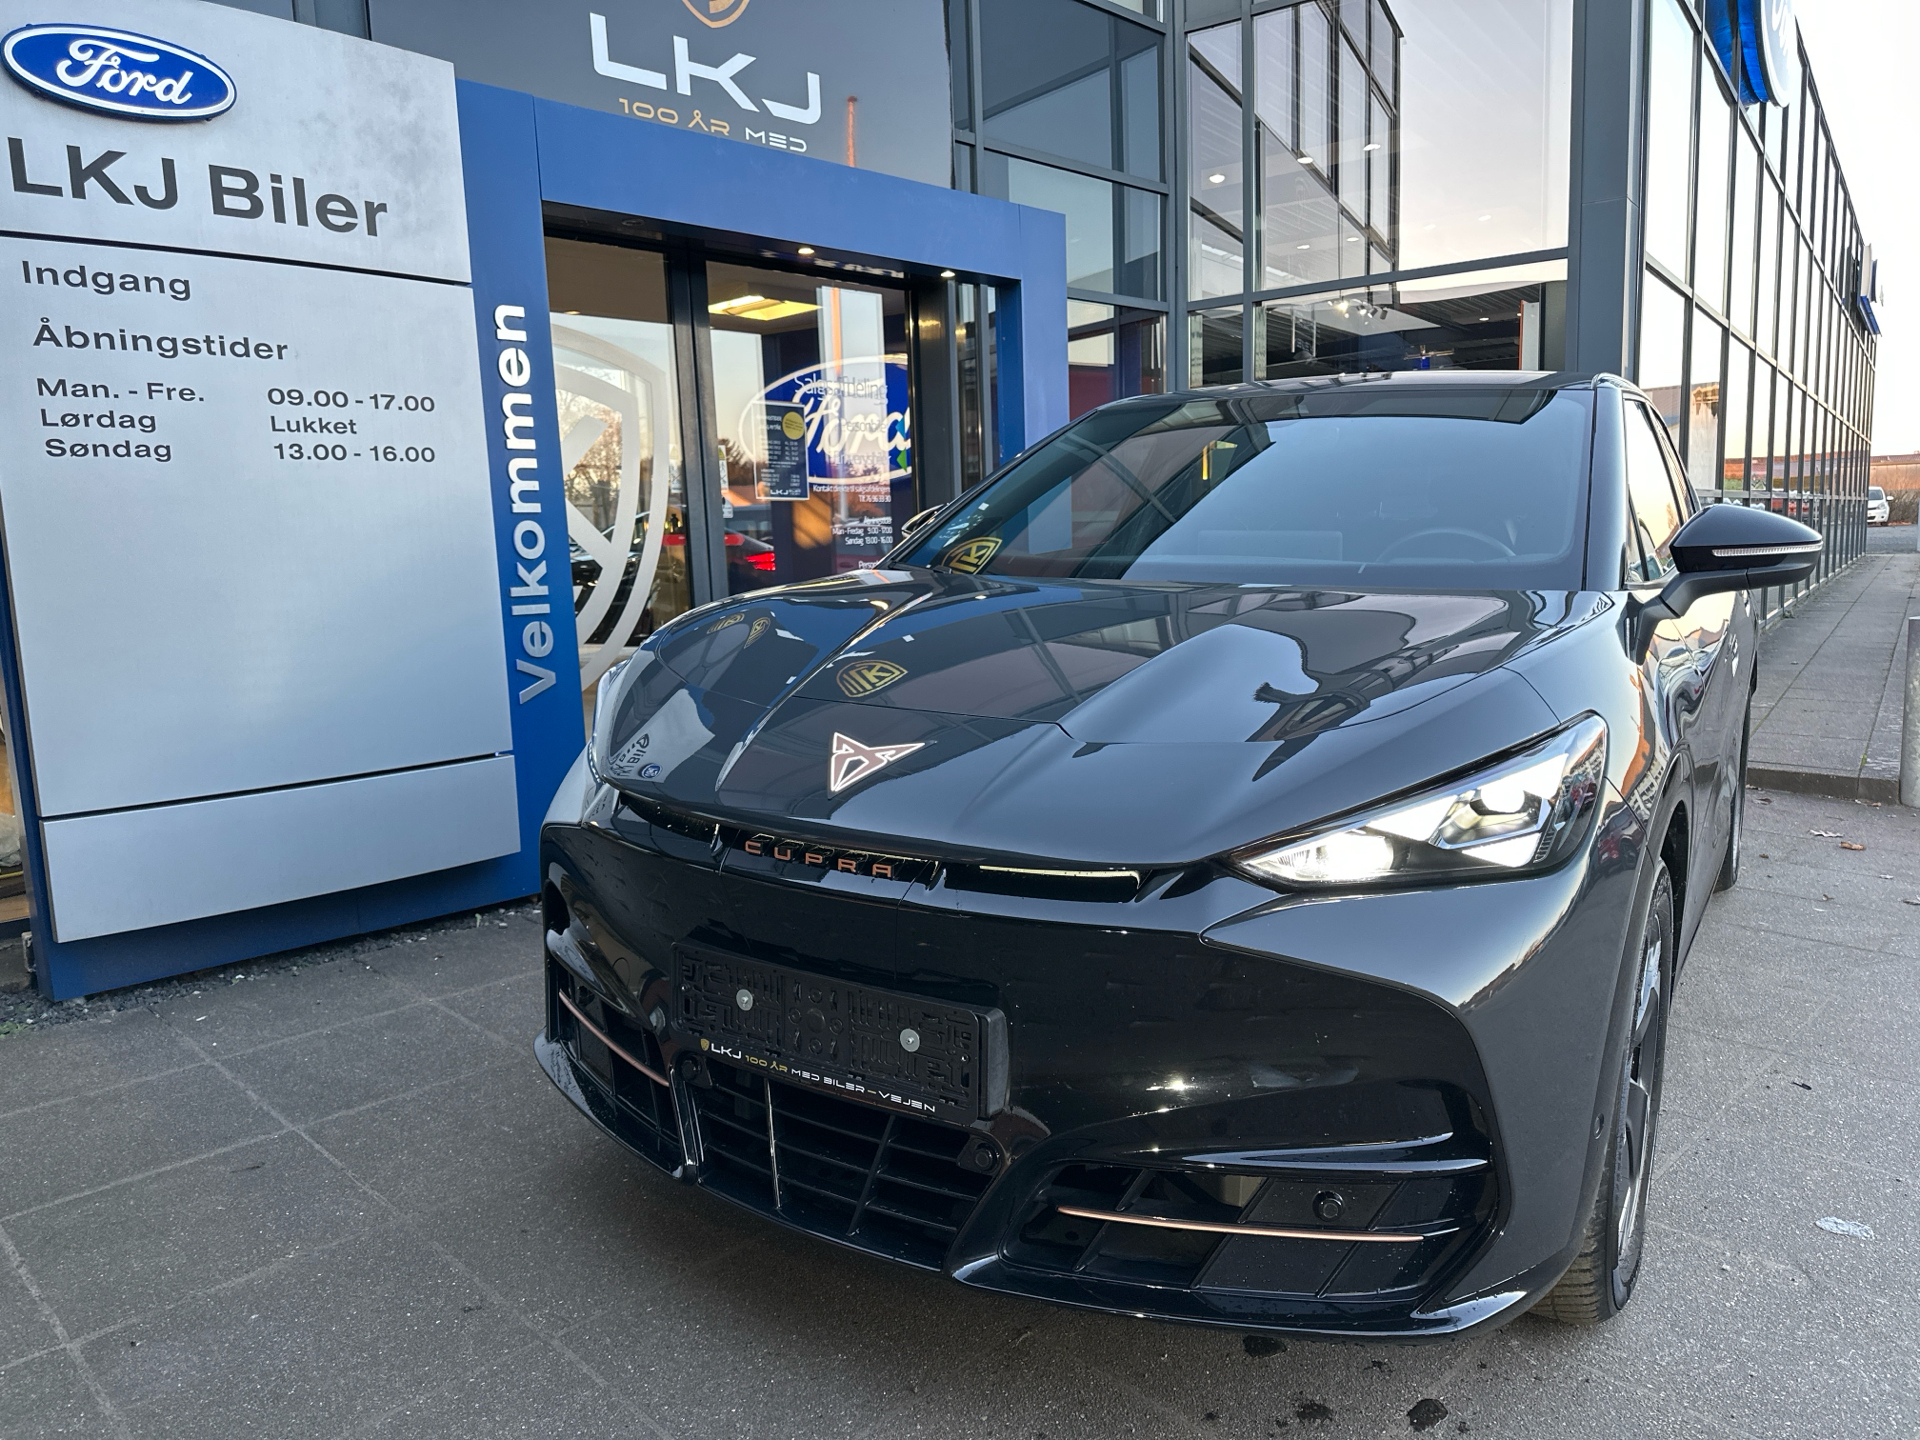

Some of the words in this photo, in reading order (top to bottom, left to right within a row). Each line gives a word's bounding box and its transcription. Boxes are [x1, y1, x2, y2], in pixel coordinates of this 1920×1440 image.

[56, 38, 193, 105] Ford
[589, 12, 822, 125] LKJ
[618, 97, 679, 125] 100
[687, 109, 730, 136] ÅR
[745, 126, 807, 153] MED
[7, 137, 180, 210] LKJ
[208, 164, 388, 237] Biler
[22, 260, 191, 302] Indgang
[33, 316, 288, 360] Åbningstider
[36, 378, 119, 399] Man.
[146, 382, 205, 402] Fre.
[40, 408, 157, 433] Lørdag
[270, 415, 358, 435] Lukket
[45, 438, 172, 463] Søndag
[495, 304, 556, 704] Velkommen
[745, 840, 892, 878] CUPRA
[711, 1043, 741, 1060] LKJ
[745, 1055, 768, 1067] 100
[791, 1068, 820, 1082] MED
[823, 1076, 865, 1094] BILER
[878, 1090, 936, 1113] VEJEN
